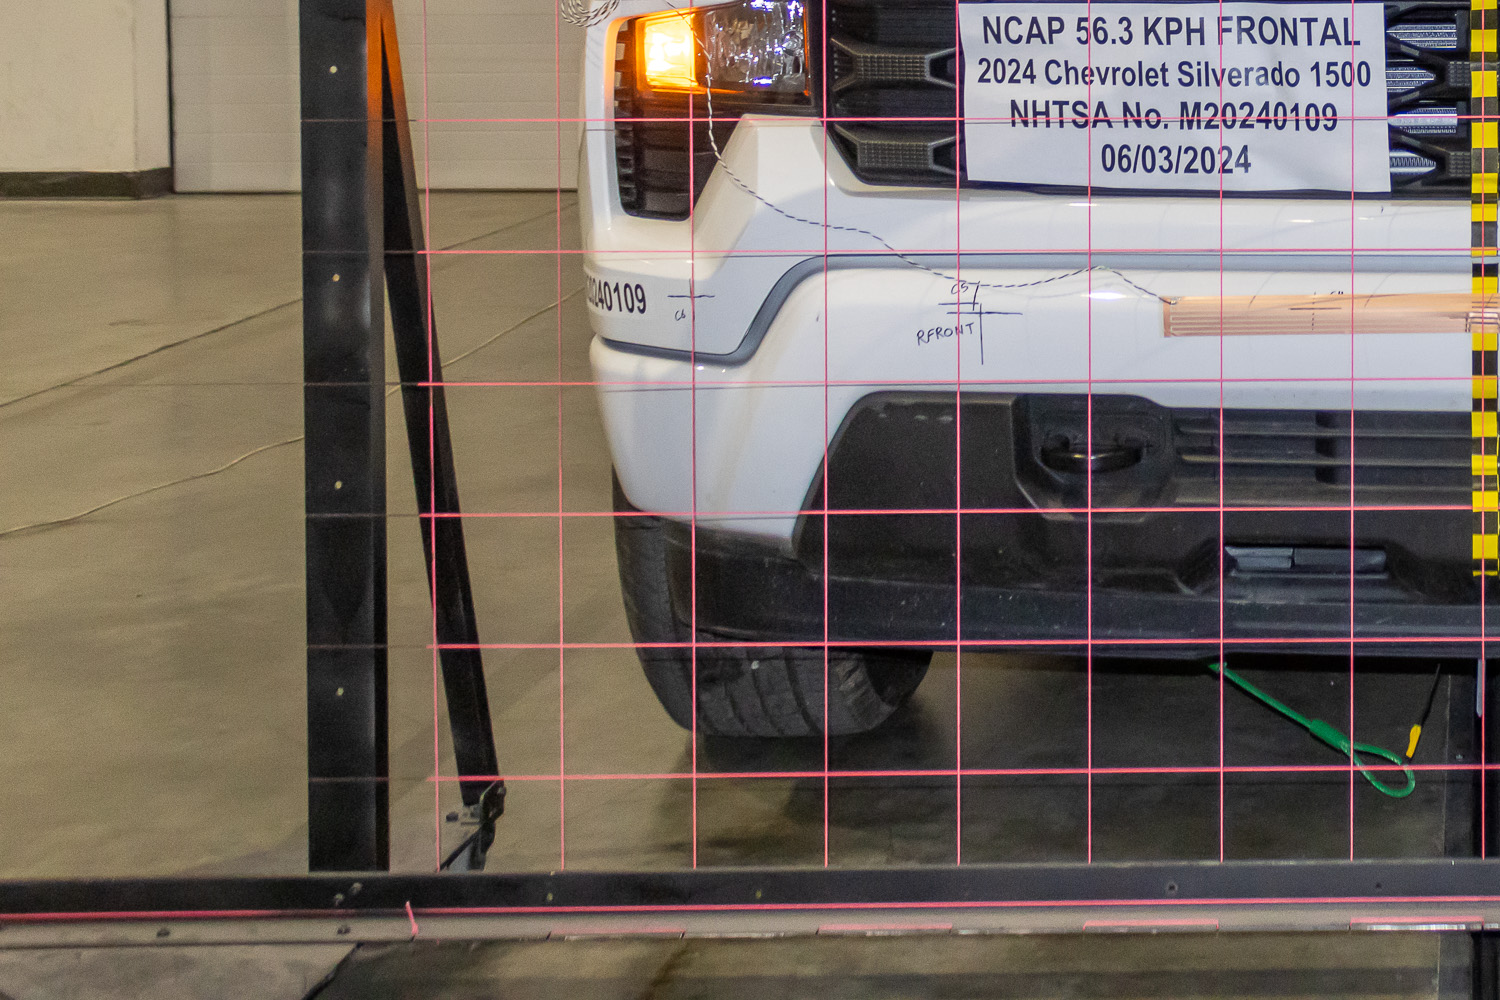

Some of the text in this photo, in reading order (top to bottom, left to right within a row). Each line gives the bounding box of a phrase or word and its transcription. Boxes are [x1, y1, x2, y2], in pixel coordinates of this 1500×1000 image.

[982, 15, 1360, 47] NCAP 56.3 KPH FRONTAL
[978, 57, 1371, 88] 2024 Chevrolet Silverado 1500
[1010, 99, 1338, 131] NHTSA No. M20240109
[1101, 144, 1252, 175] 06/03/2024
